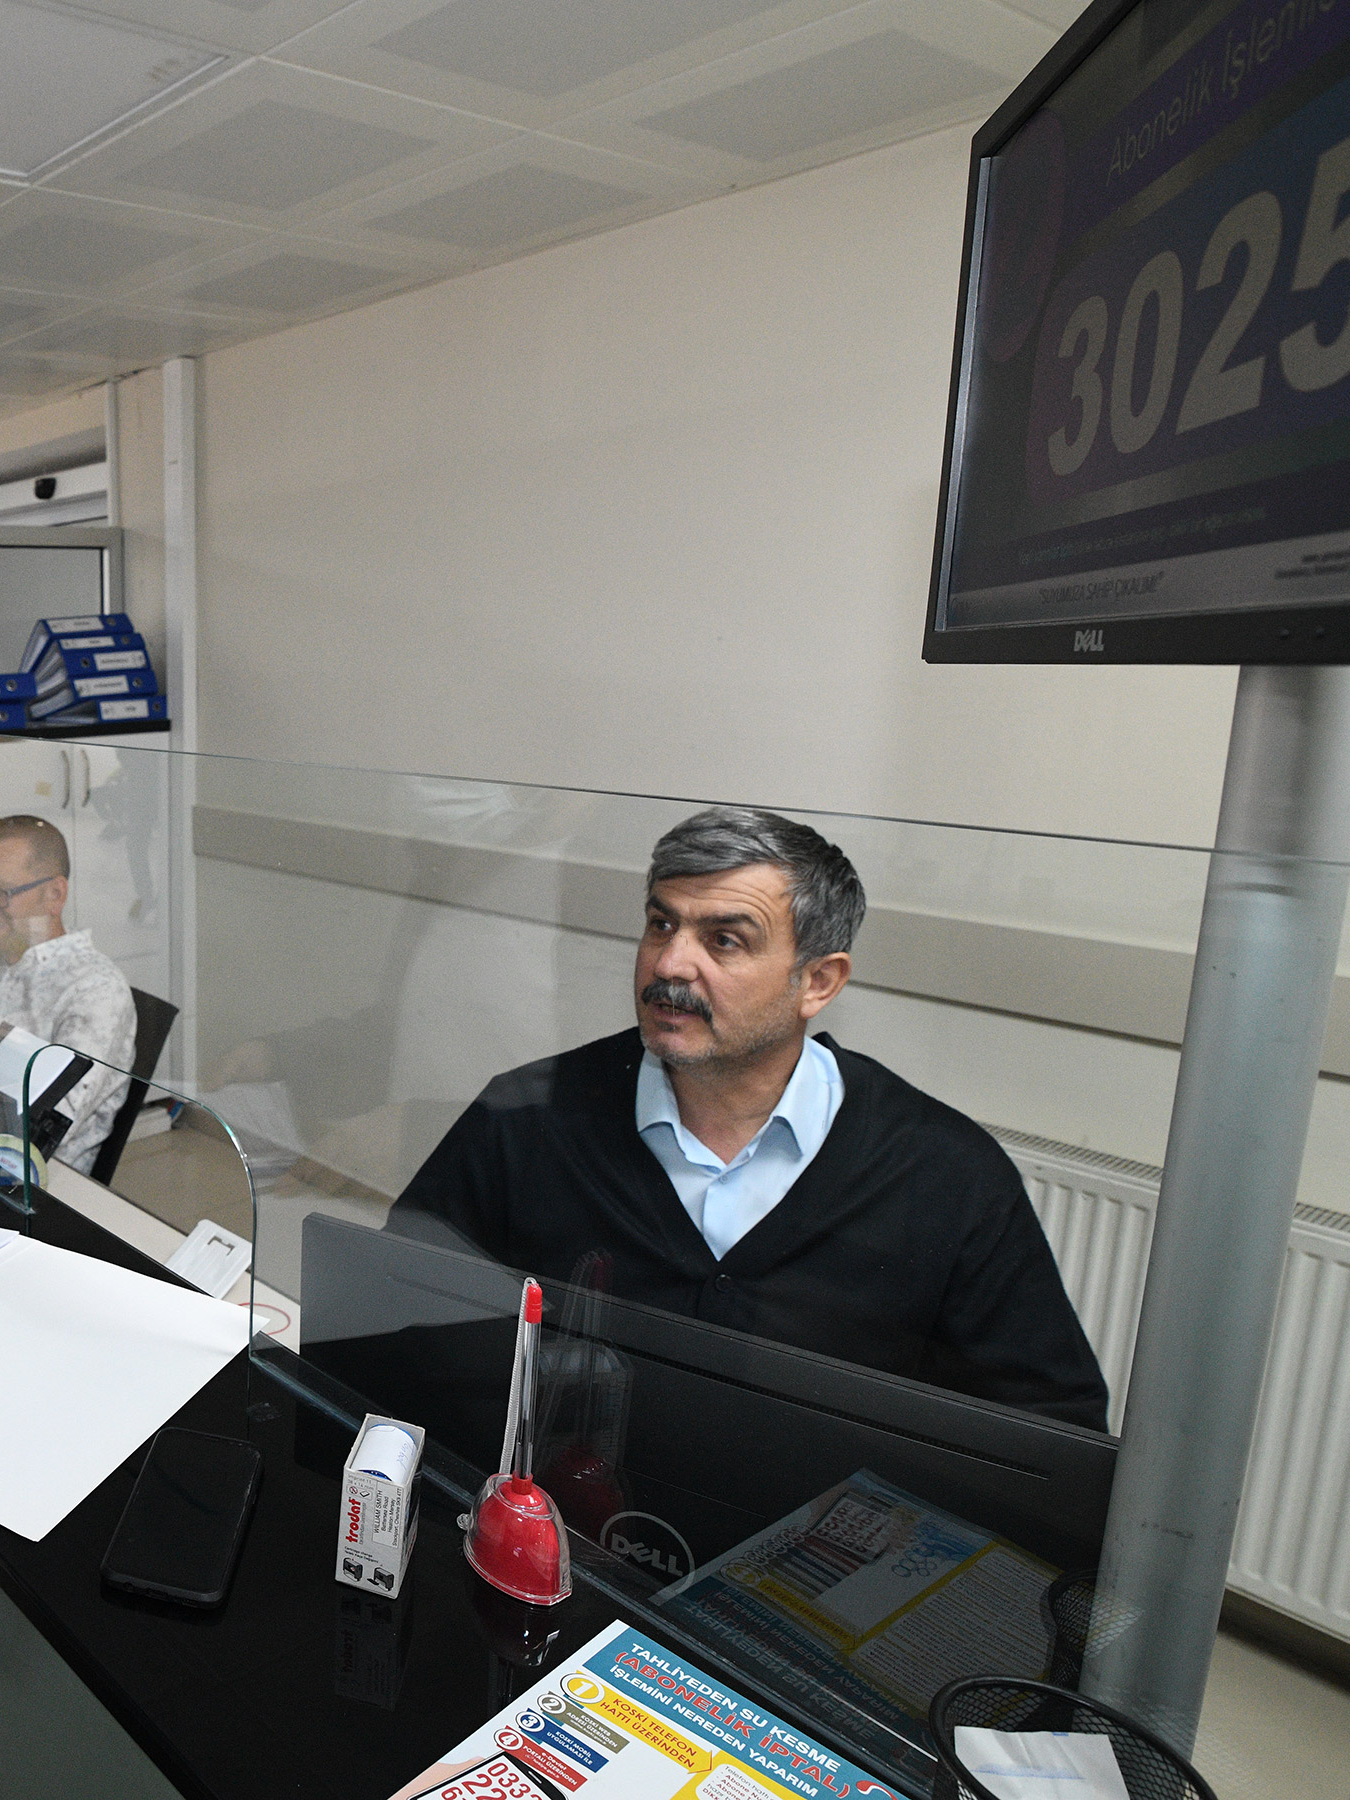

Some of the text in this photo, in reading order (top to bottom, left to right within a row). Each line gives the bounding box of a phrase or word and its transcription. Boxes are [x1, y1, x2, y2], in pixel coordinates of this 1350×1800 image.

[1073, 629, 1104, 652] DELL
[346, 1499, 361, 1543] trodat
[611, 1533, 682, 1577] DELL
[572, 1681, 593, 1696] 1
[543, 1696, 559, 1711] 2
[631, 1643, 840, 1772] TAHLİYEDEN SU KESME
[522, 1713, 538, 1729] 3
[597, 1725, 611, 1736] WEB
[610, 1664, 818, 1797] İŞLEMİNİ NEREDEN YAPARIM
[613, 1698, 697, 1756] KOSKİ TELEFON
[615, 1652, 850, 1797] (ABONELİK İPTAL)
[500, 1731, 516, 1747] 4
[600, 1702, 695, 1768] HATTI ÜZERİNDEN
[725, 1766, 751, 1786] Telefon
[725, 1775, 750, 1792] Abone
[721, 1779, 745, 1797] Abone
